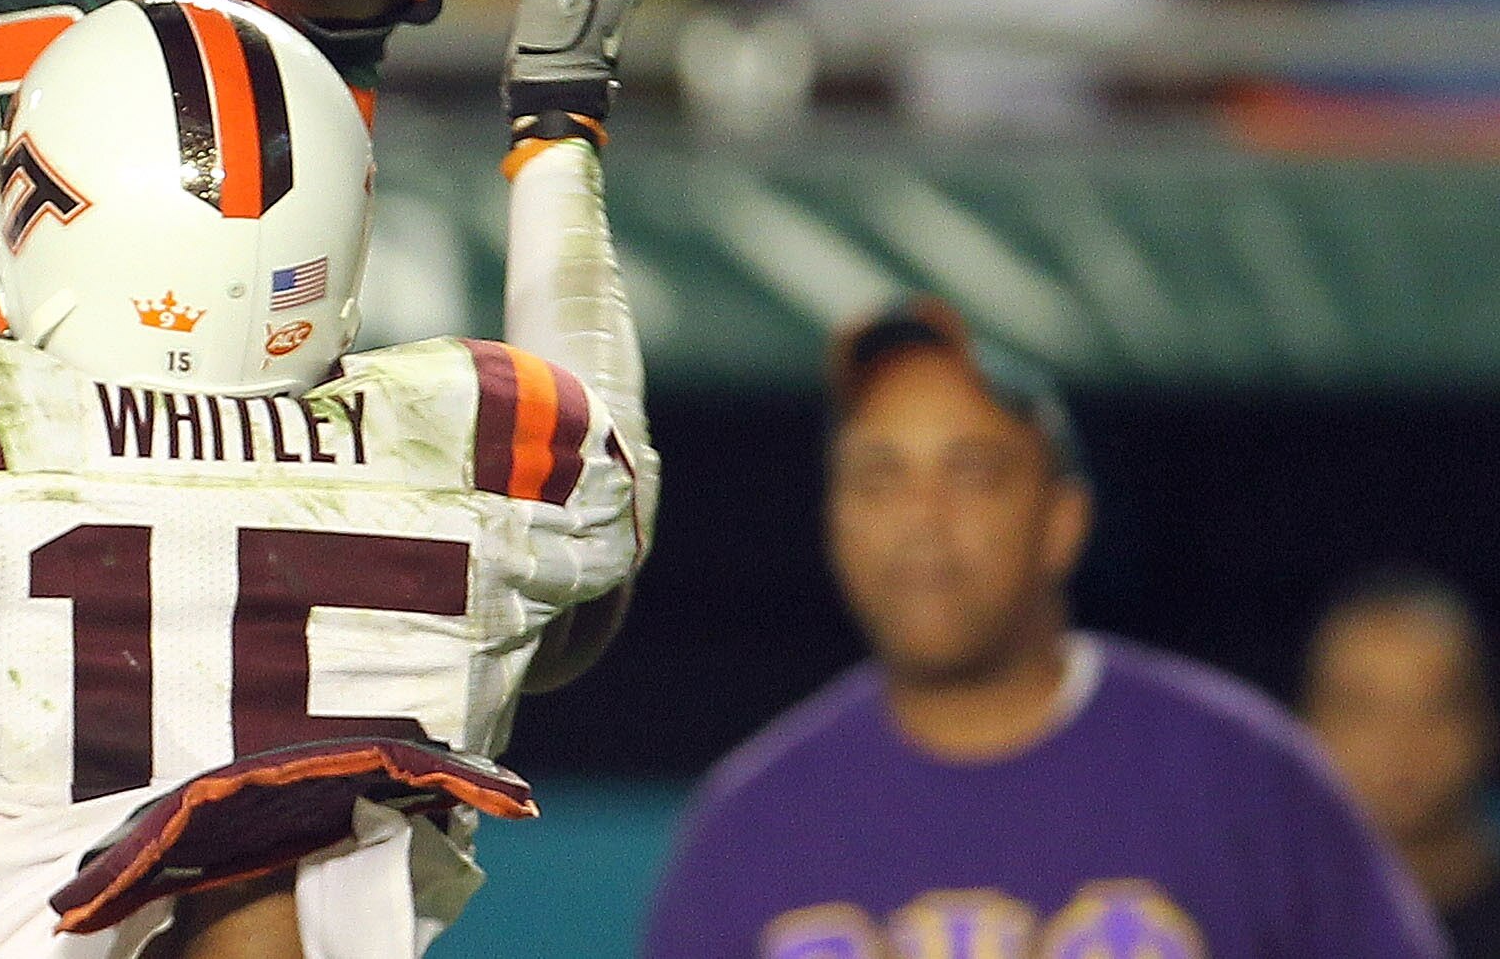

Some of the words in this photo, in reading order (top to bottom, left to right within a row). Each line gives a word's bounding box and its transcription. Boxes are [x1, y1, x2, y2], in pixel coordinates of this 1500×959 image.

[159, 311, 176, 328] 9
[167, 350, 191, 372] 15
[94, 382, 368, 464] WHITLEY
[29, 523, 470, 803] 15
